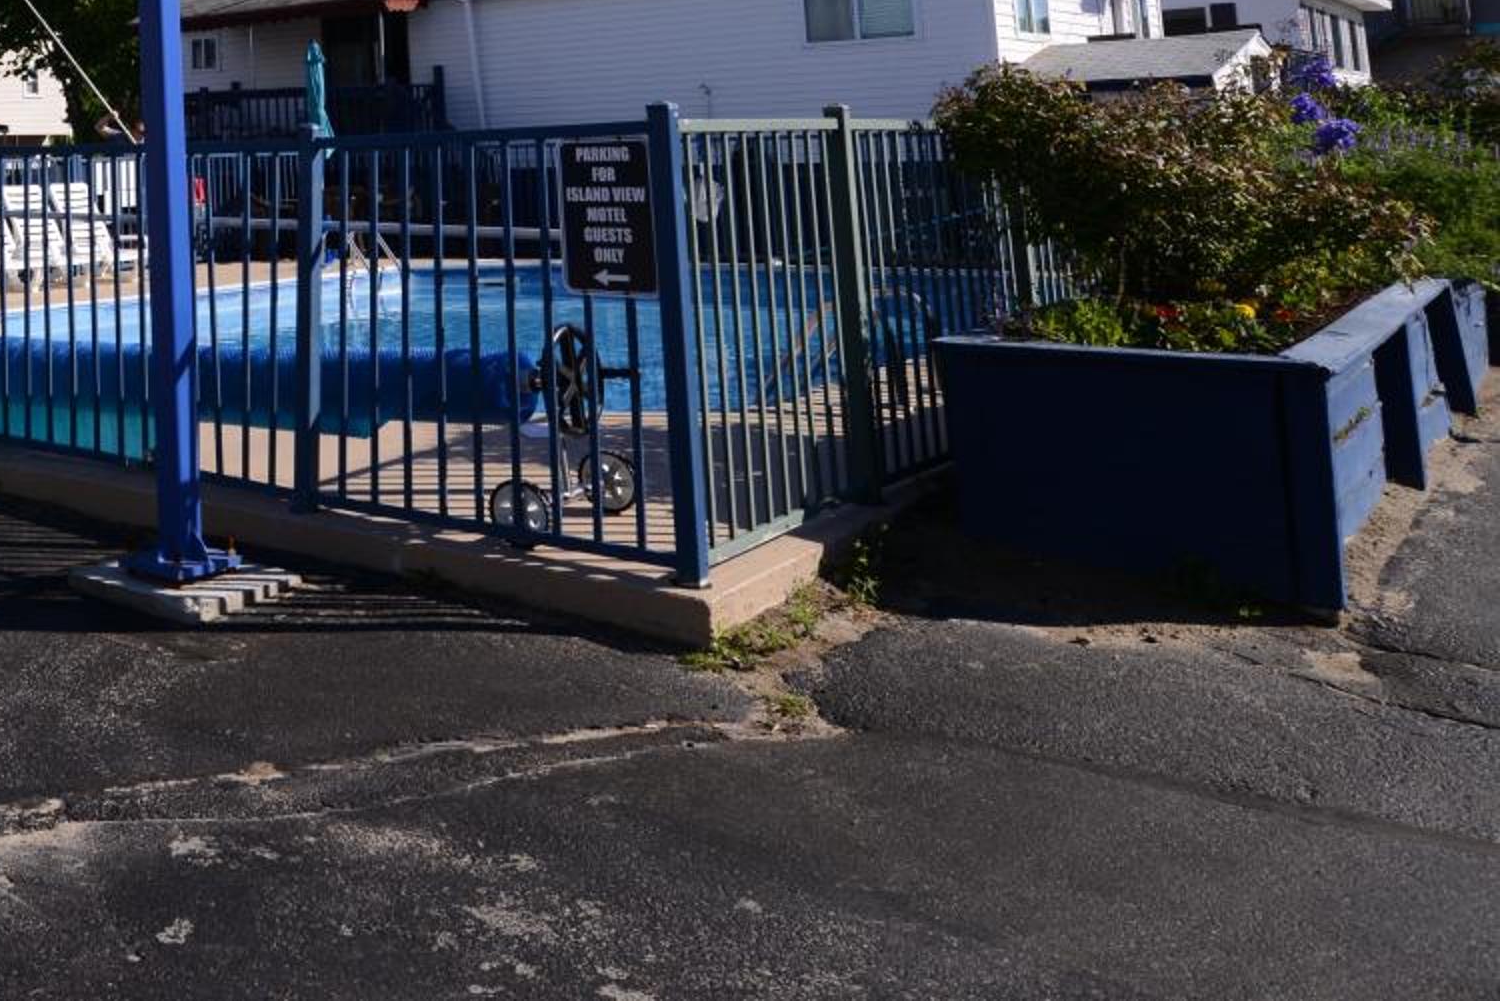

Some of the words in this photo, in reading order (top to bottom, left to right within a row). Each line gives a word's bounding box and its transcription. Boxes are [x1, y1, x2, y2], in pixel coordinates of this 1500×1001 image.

[575, 146, 630, 162] PARKING
[591, 167, 616, 182] FOR
[566, 186, 610, 202] ISLAND
[612, 187, 645, 202] VIEW
[586, 207, 627, 222] MOTEL
[584, 227, 633, 243] GUESTS
[594, 247, 625, 263] ONLY
